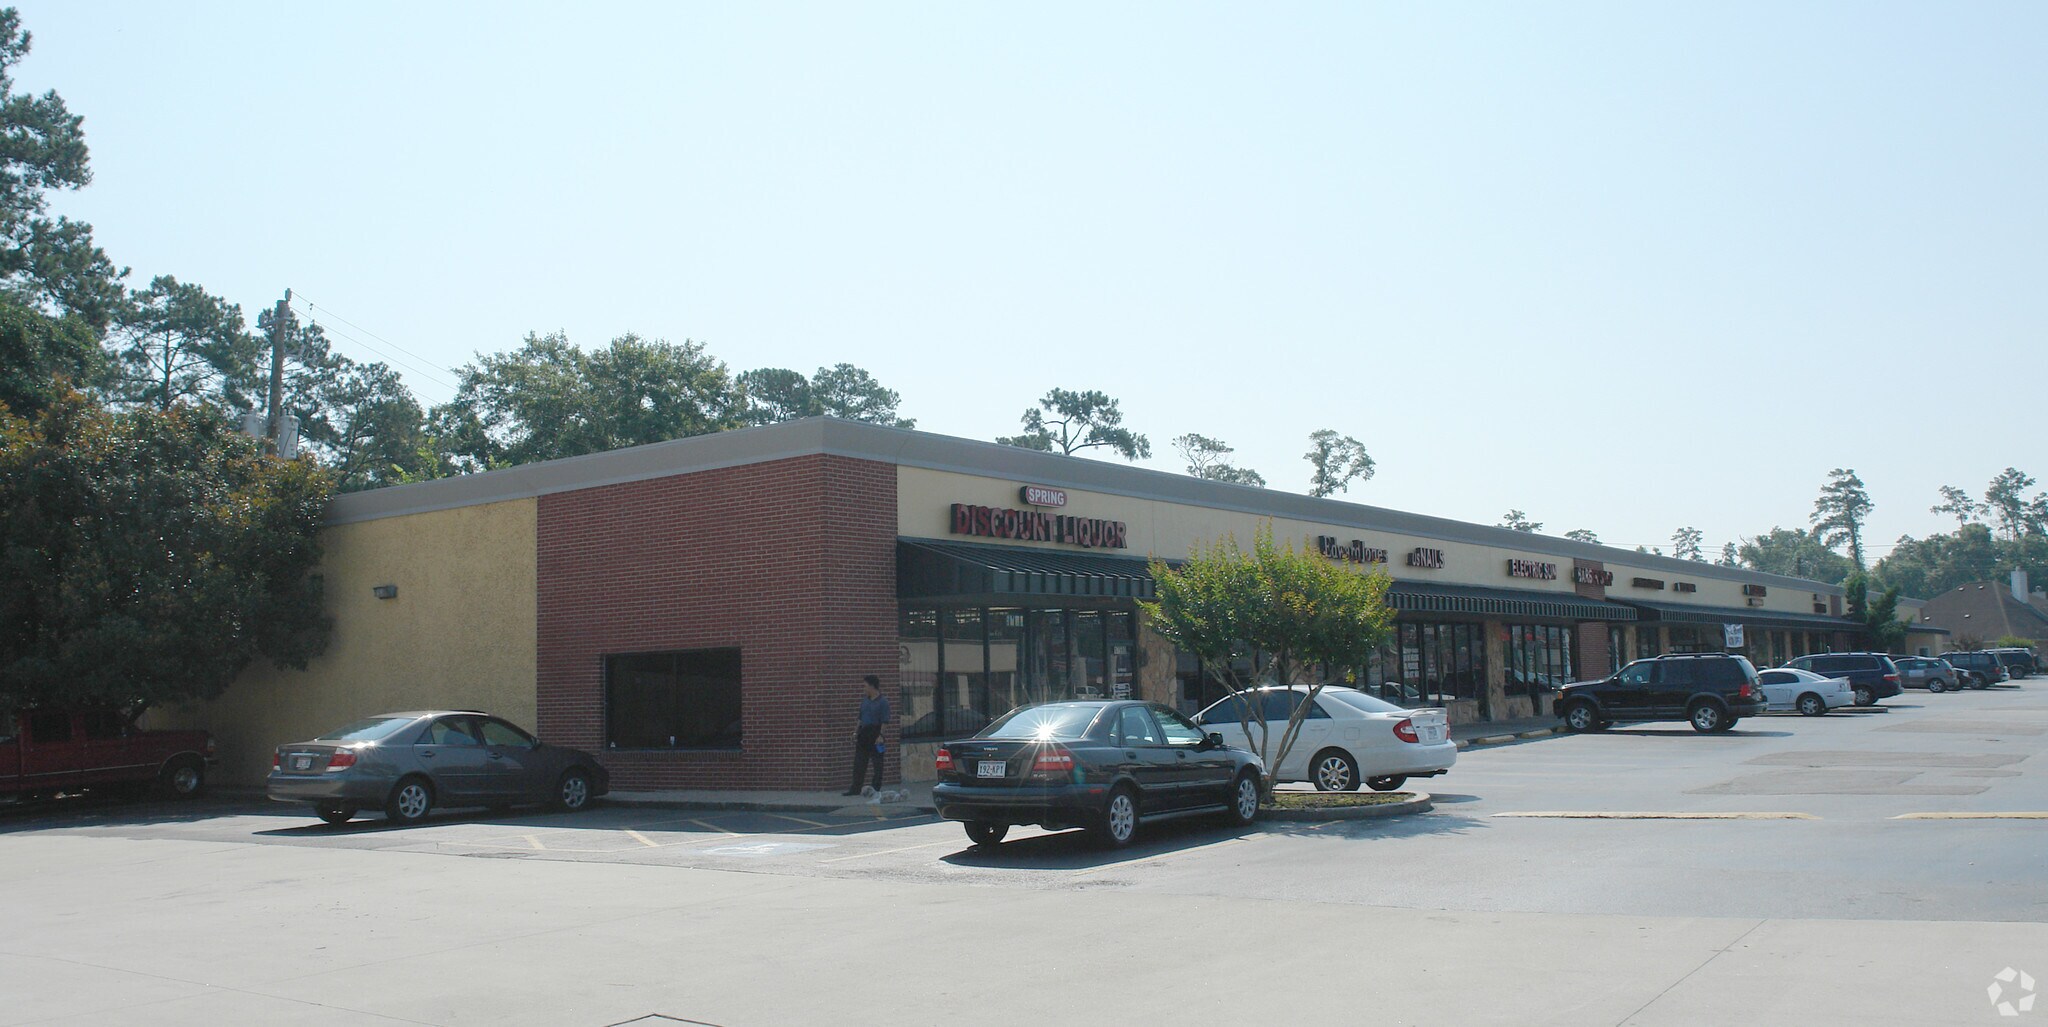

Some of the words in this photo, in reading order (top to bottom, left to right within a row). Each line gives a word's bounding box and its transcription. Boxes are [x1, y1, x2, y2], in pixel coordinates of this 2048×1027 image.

[1028, 488, 1064, 505] SPRING
[952, 503, 1057, 542] DISCOUNT
[1060, 514, 1128, 549] LIQUOR
[1361, 541, 1388, 563] Jones
[1420, 547, 1446, 569] NAILS
[1510, 559, 1543, 579] ELECTRIC
[1544, 562, 1557, 580] SUN
